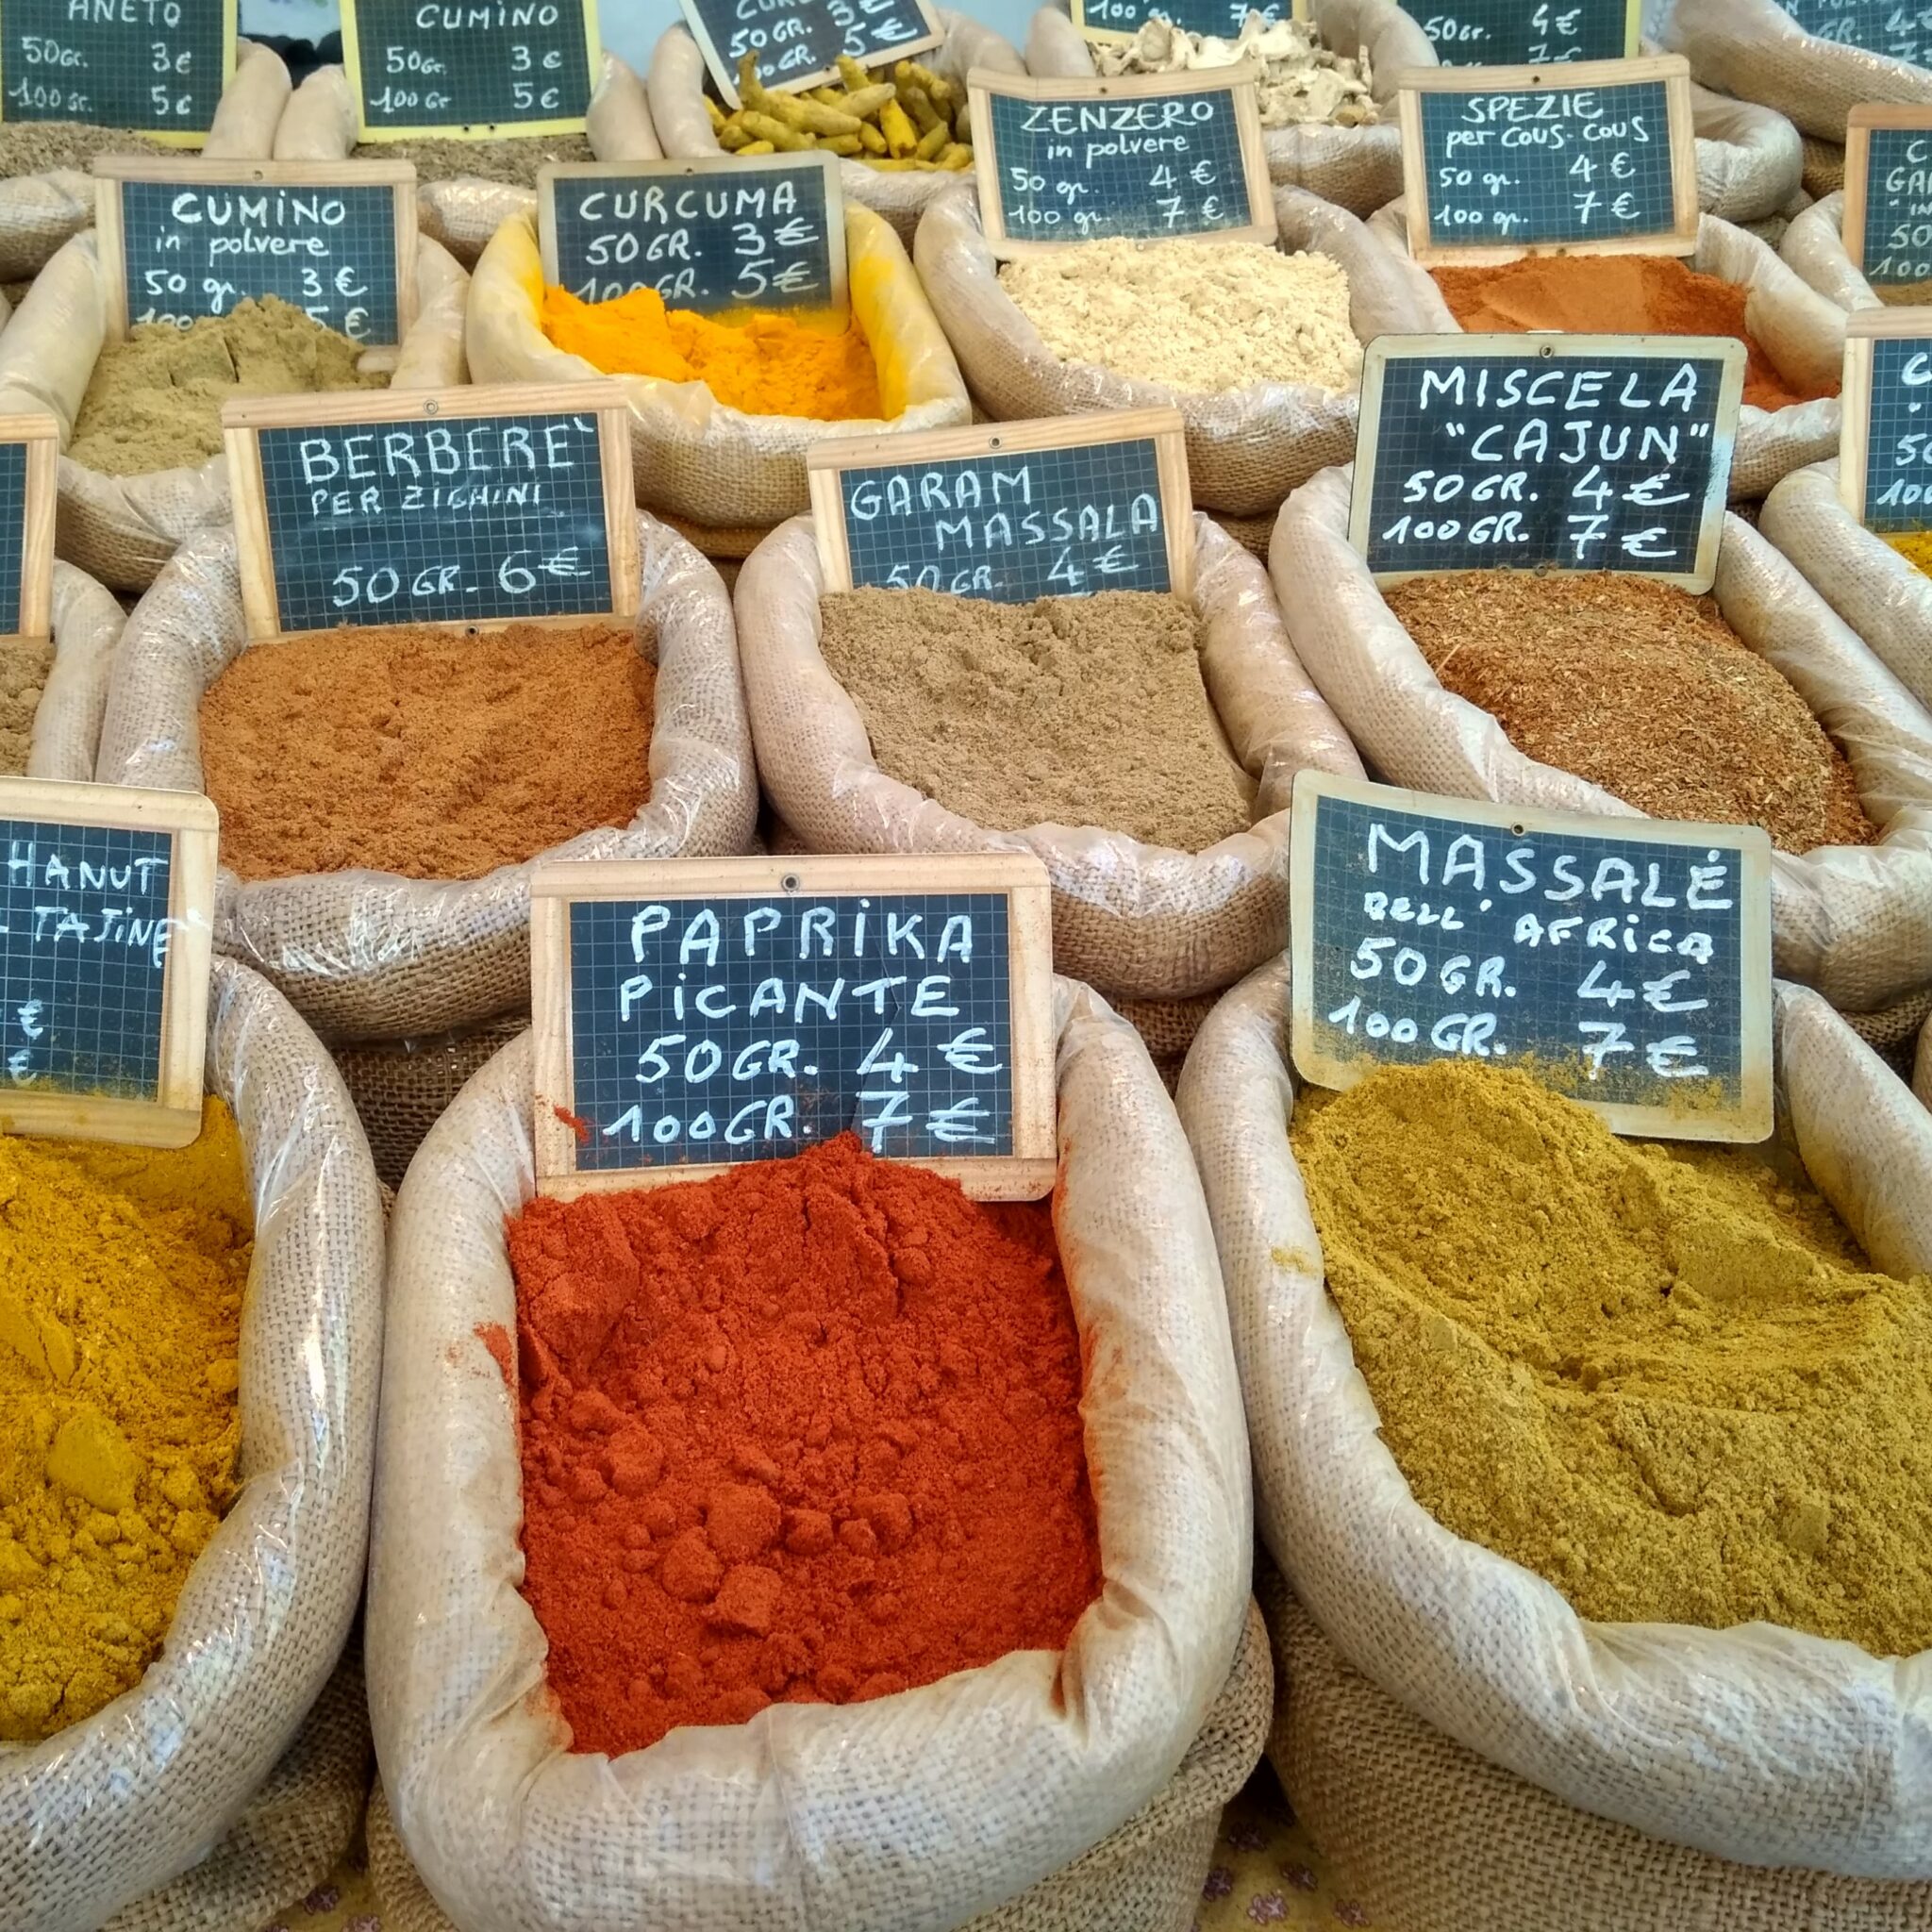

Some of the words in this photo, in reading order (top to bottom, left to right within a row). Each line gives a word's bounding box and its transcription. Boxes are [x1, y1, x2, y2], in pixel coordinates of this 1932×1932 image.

[68, 0, 181, 27] ANETO
[1021, 101, 1214, 135] ZENZERO
[1461, 92, 1604, 124] SPEZIE
[1047, 141, 1073, 159] in
[1086, 134, 1190, 169] polvere
[1446, 129, 1496, 158] per
[579, 181, 796, 224] CURCUMA
[157, 225, 180, 253] in
[209, 228, 329, 268] polvere
[1419, 362, 1699, 412] MISCELA
[1445, 418, 1709, 463] "CAJUN"
[311, 486, 382, 517] PER
[851, 465, 1030, 521] GARAM
[935, 492, 1158, 551] MASSALA
[8, 841, 169, 895] HANUT
